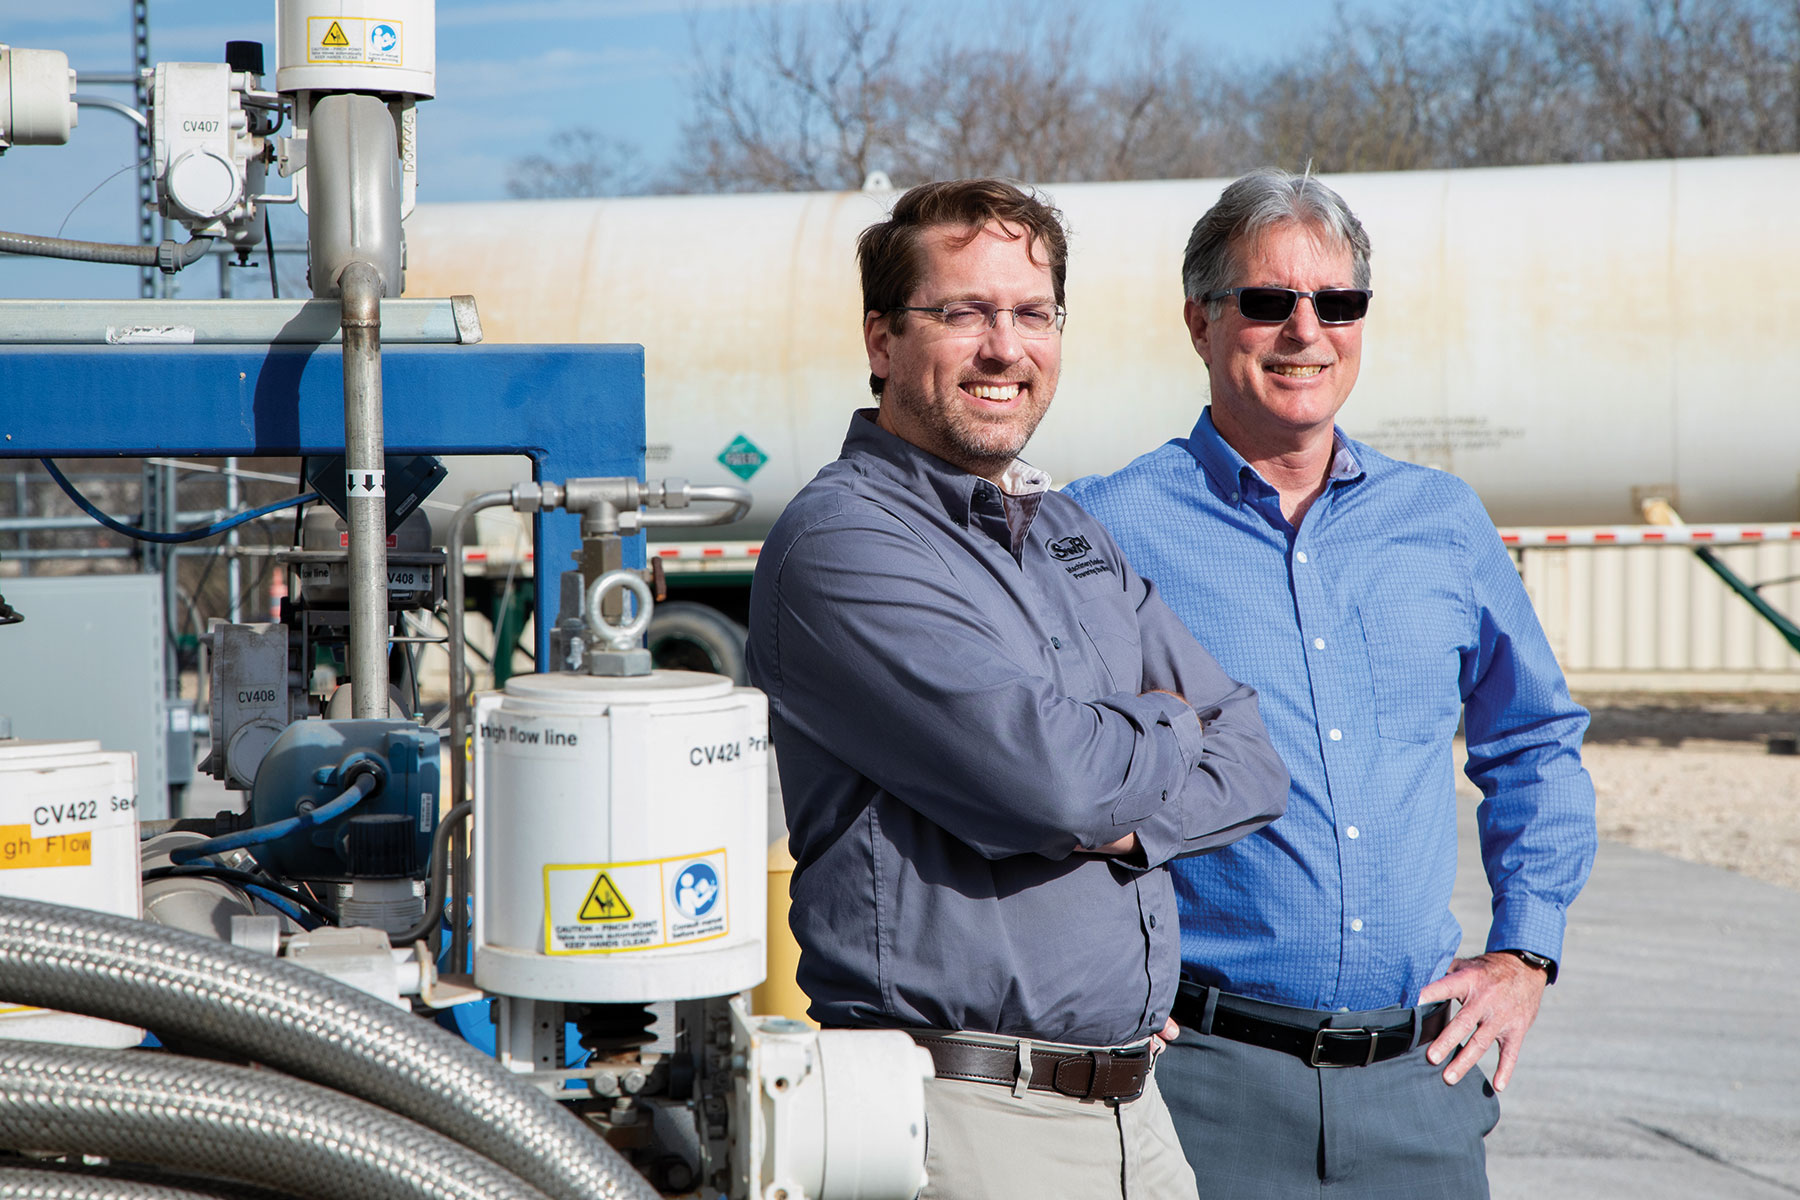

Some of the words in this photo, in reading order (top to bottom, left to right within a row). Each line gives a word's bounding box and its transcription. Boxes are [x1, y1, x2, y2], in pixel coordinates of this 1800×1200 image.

[183, 121, 219, 132] CV407
[387, 572, 414, 584] V408
[238, 690, 276, 703] CV408
[545, 729, 578, 746] line
[690, 742, 740, 766] CV424
[34, 800, 98, 826] CV422
